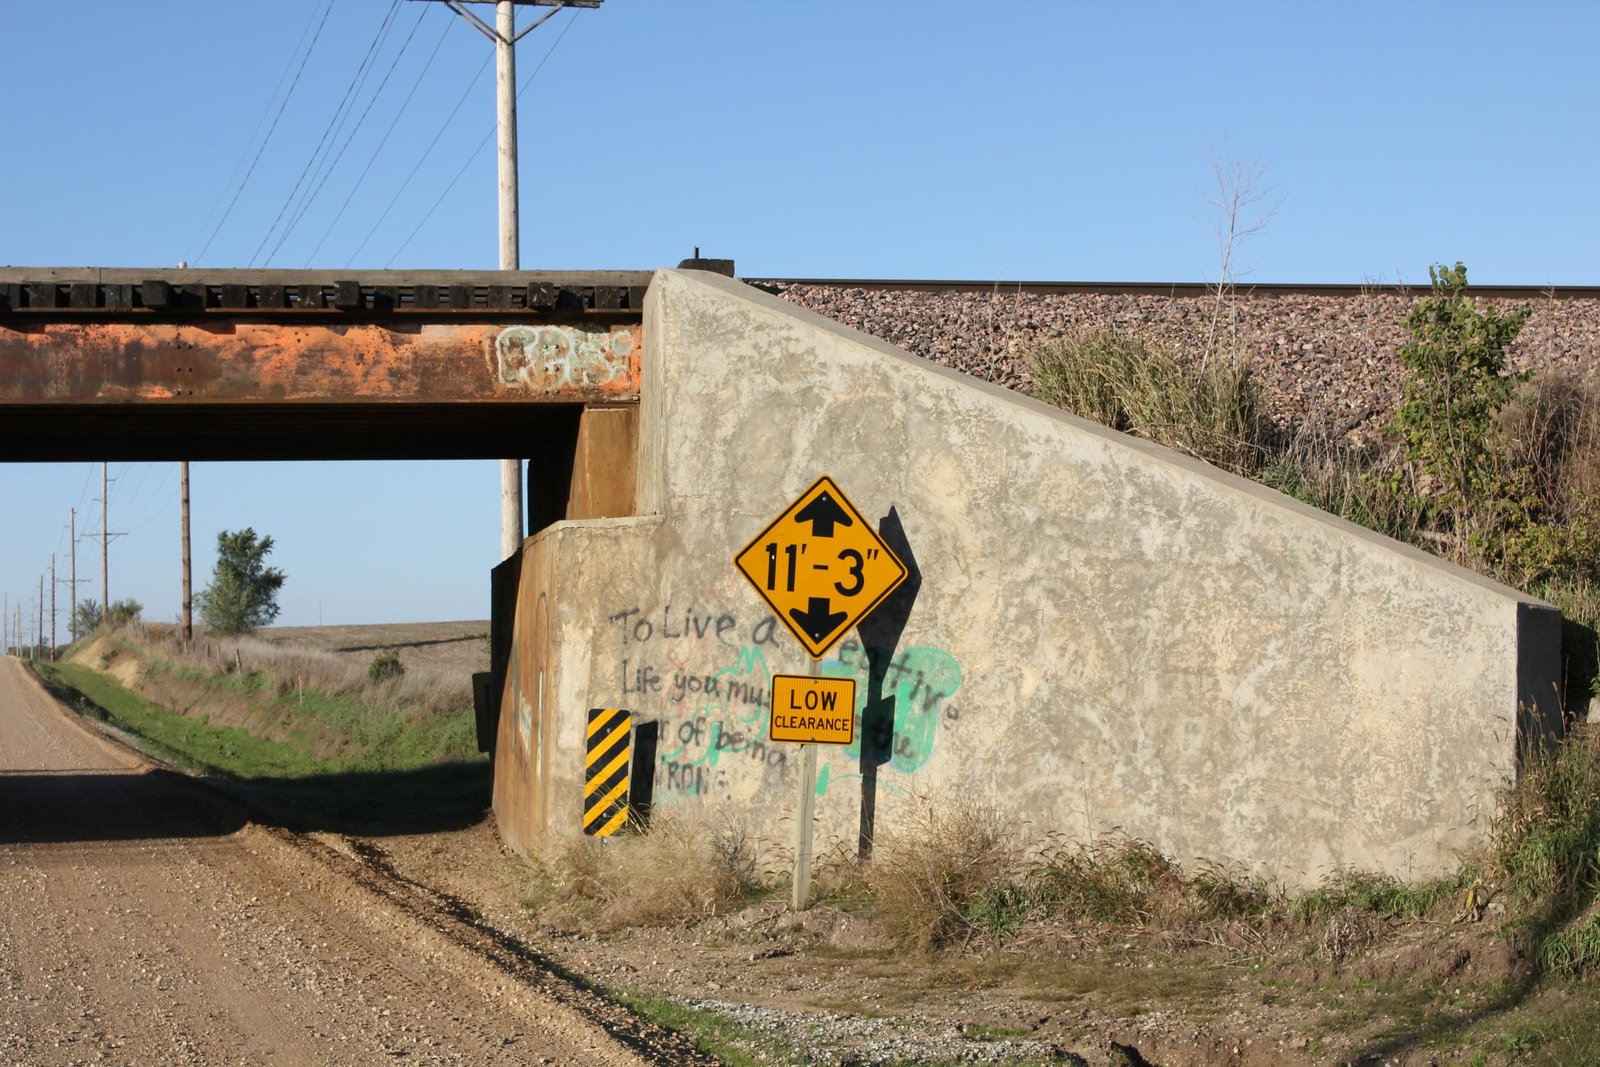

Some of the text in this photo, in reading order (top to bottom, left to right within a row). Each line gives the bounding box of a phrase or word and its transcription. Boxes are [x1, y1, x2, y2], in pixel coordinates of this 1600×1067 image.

[609, 607, 653, 645] To
[663, 604, 737, 648] Live
[751, 614, 780, 649] a
[622, 659, 771, 710] Life you mu
[790, 688, 838, 712] LOW
[678, 715, 707, 747] of
[774, 716, 850, 732] CLEARANCE
